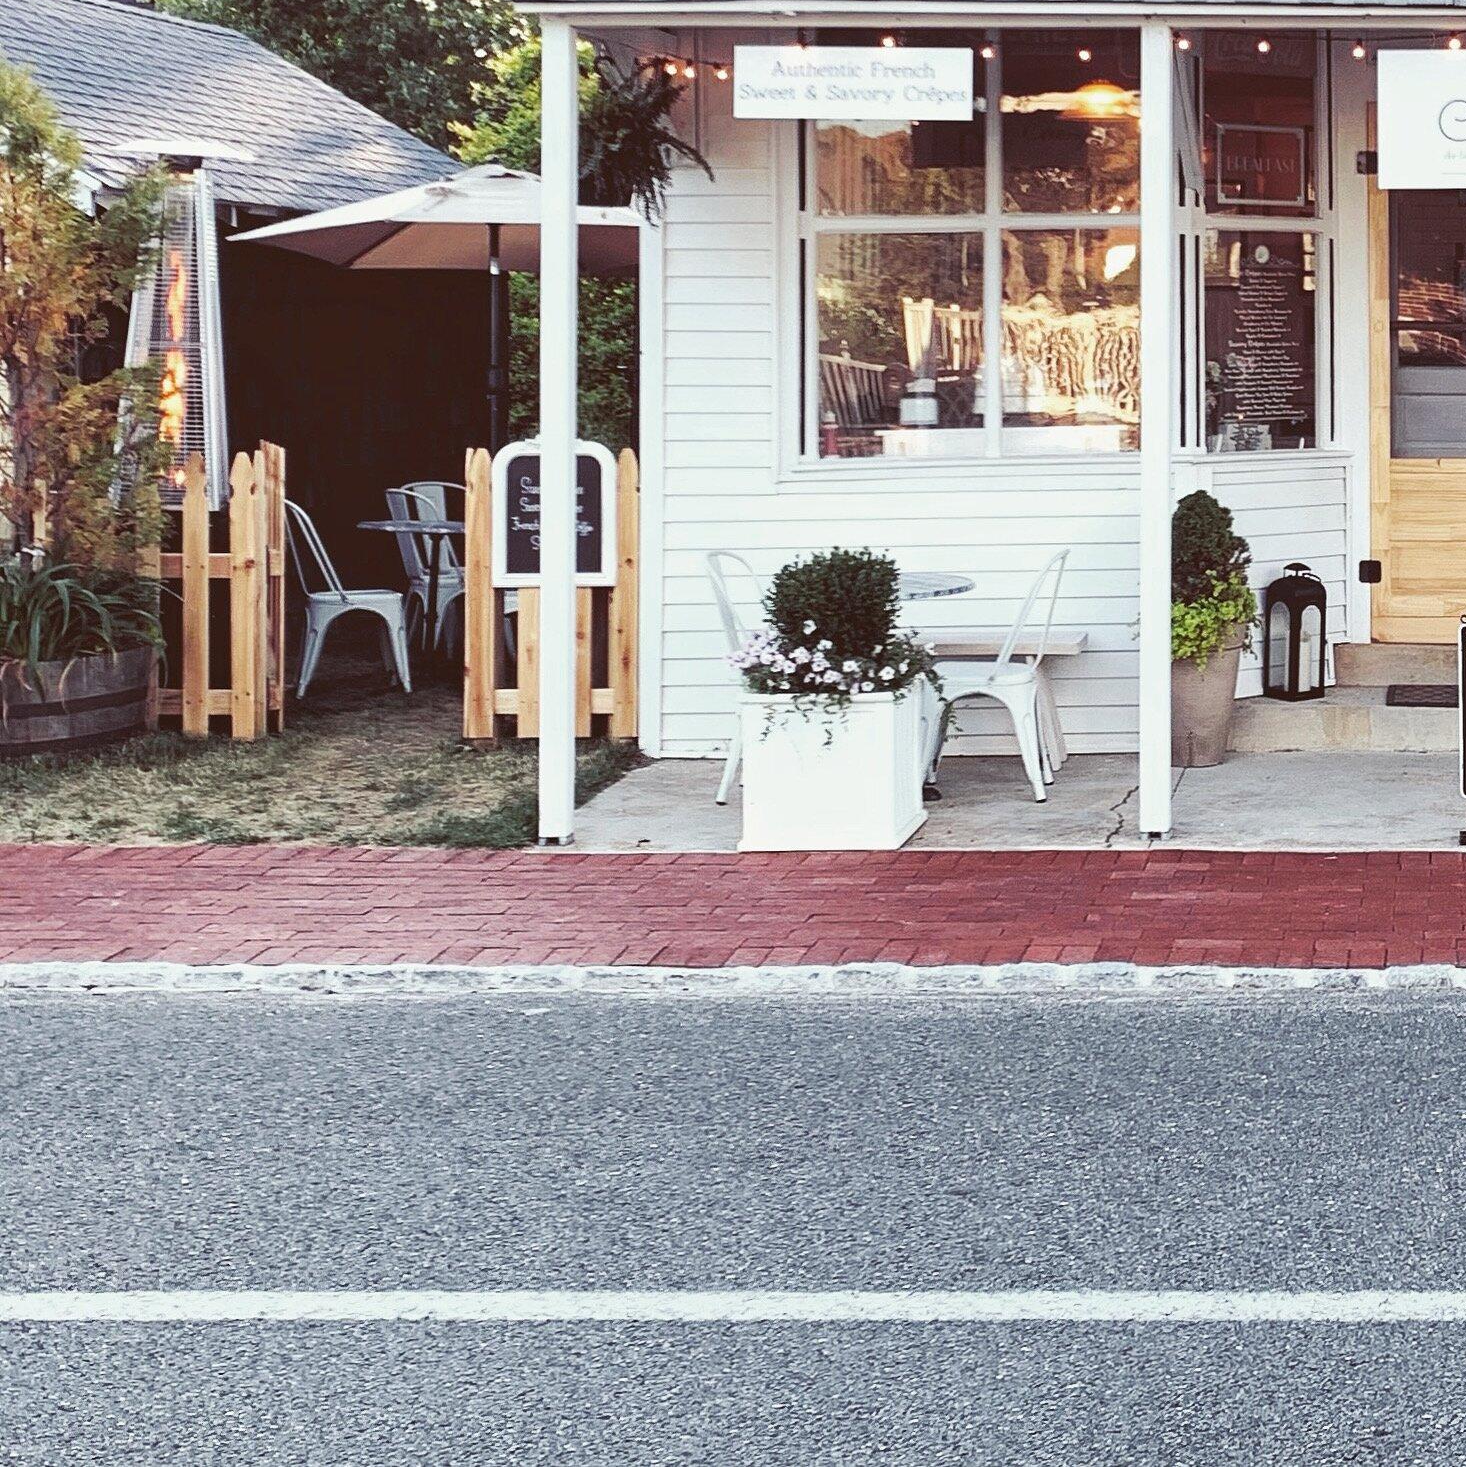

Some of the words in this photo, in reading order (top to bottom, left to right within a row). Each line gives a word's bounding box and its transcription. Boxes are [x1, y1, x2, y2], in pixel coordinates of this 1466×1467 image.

[771, 60, 862, 79] Authentic
[870, 60, 936, 79] French
[739, 83, 796, 101] Sweet
[804, 84, 818, 101] &
[826, 84, 896, 104] Savory
[903, 83, 968, 106] Crêpes
